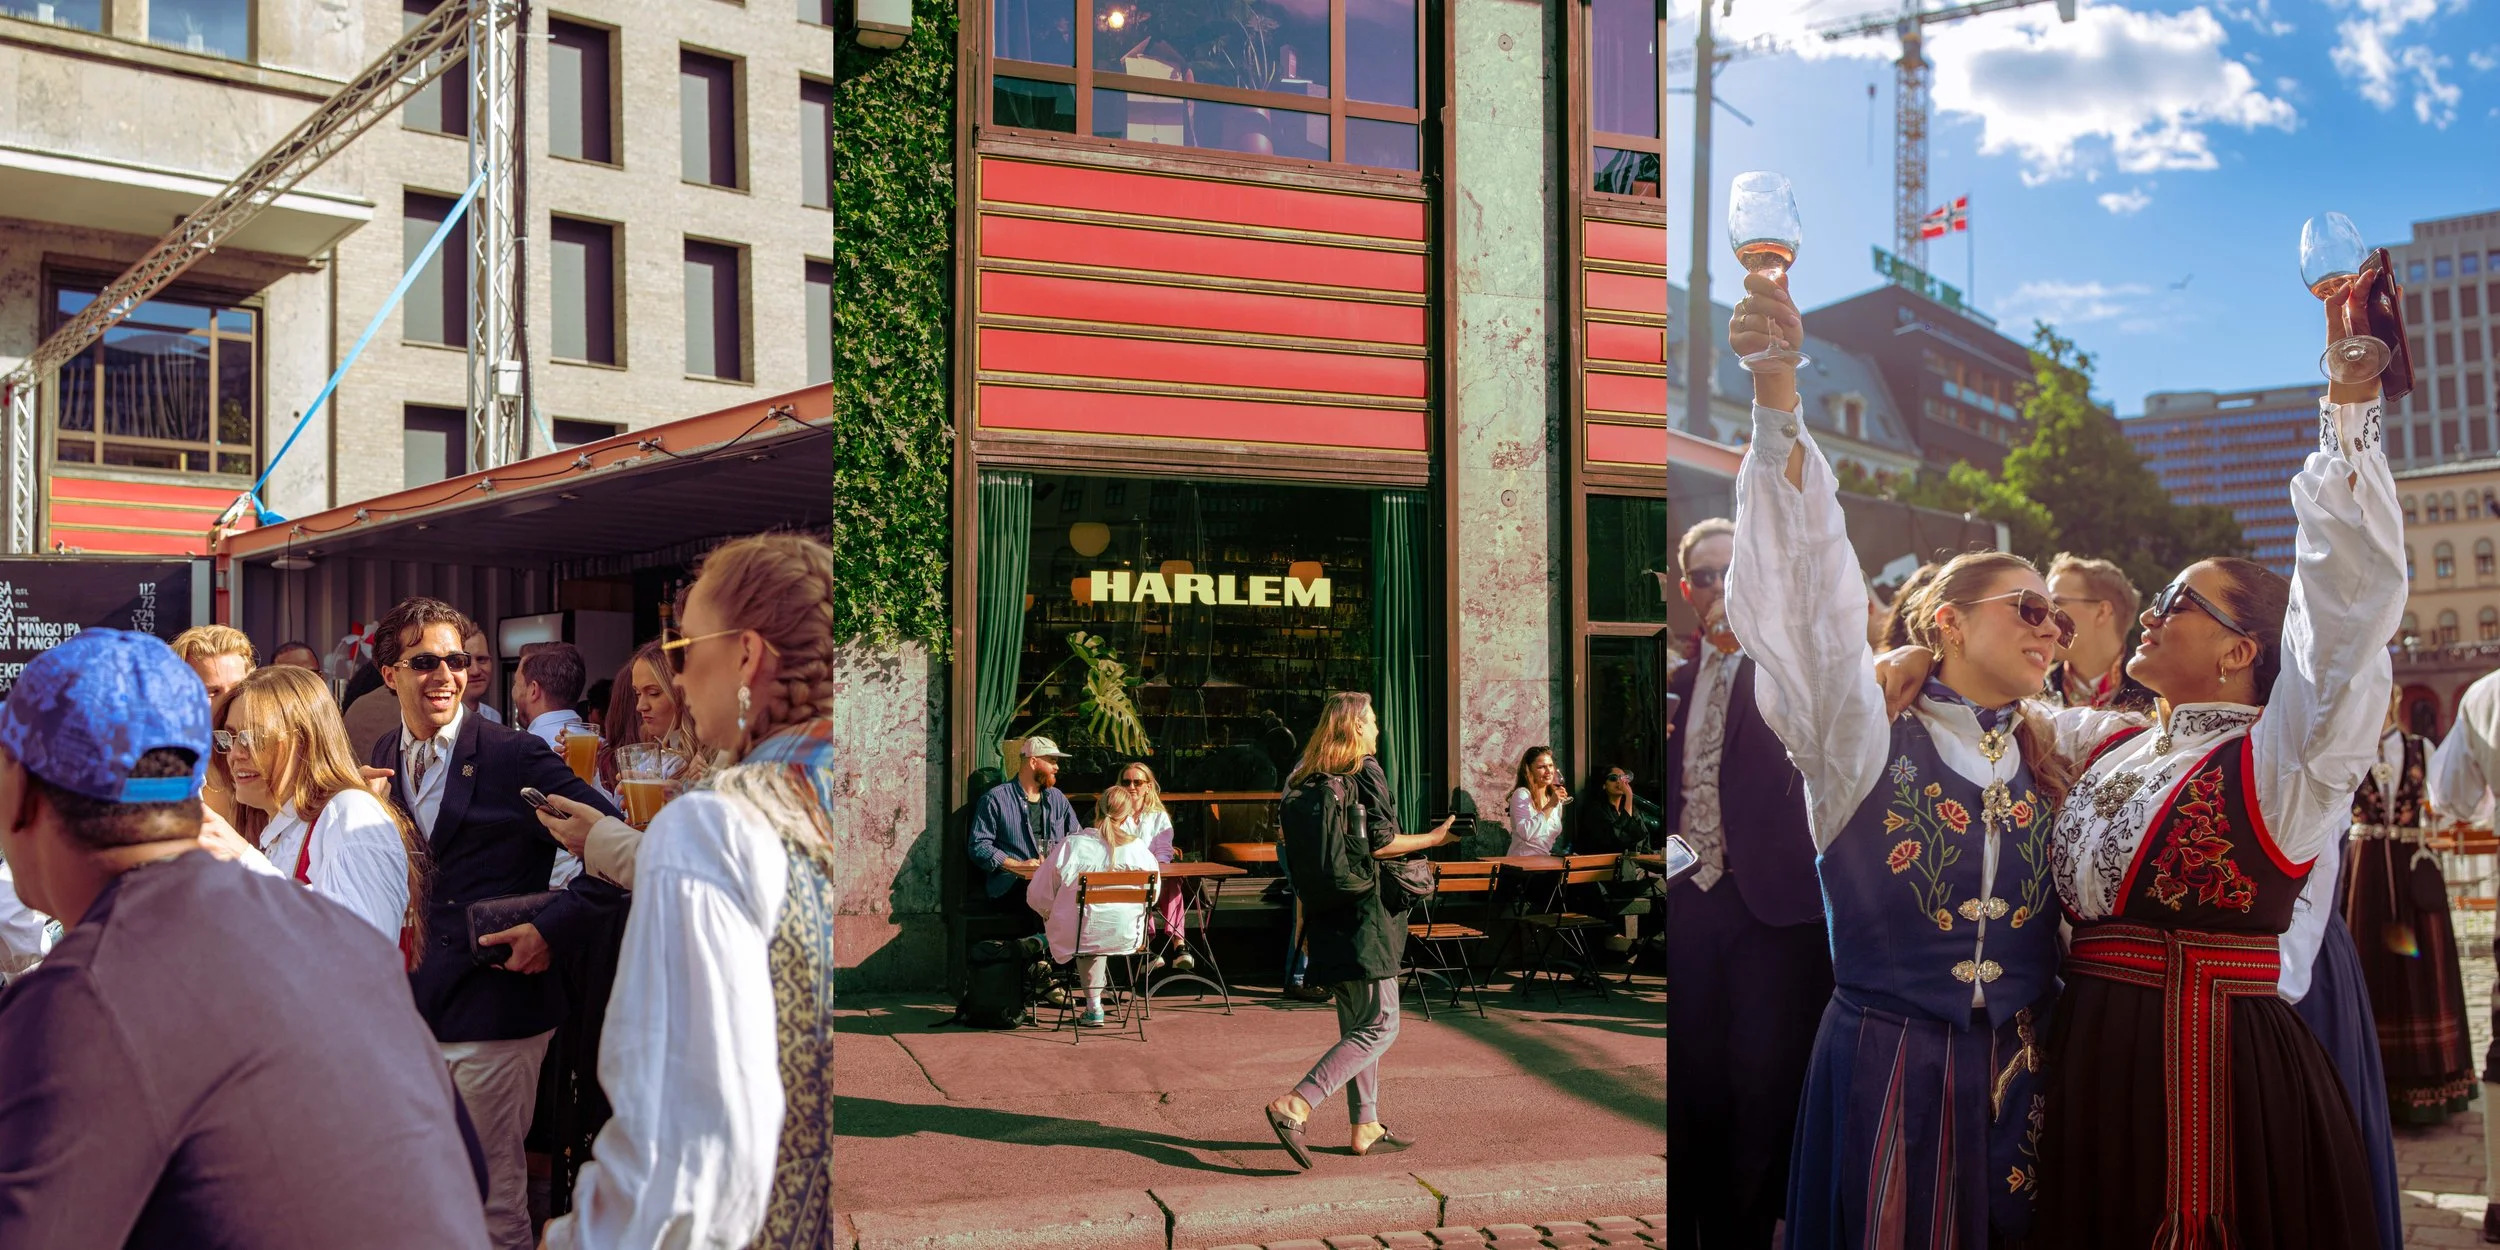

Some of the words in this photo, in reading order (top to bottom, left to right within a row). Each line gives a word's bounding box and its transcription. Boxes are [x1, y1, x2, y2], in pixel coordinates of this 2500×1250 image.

[139, 582, 156, 595] 112
[1091, 570, 1331, 607] HARLEM
[141, 596, 156, 608] 72
[131, 609, 155, 622] 324
[17, 622, 61, 637] MANGO
[63, 622, 81, 636] IPA
[17, 636, 61, 650] MANGO
